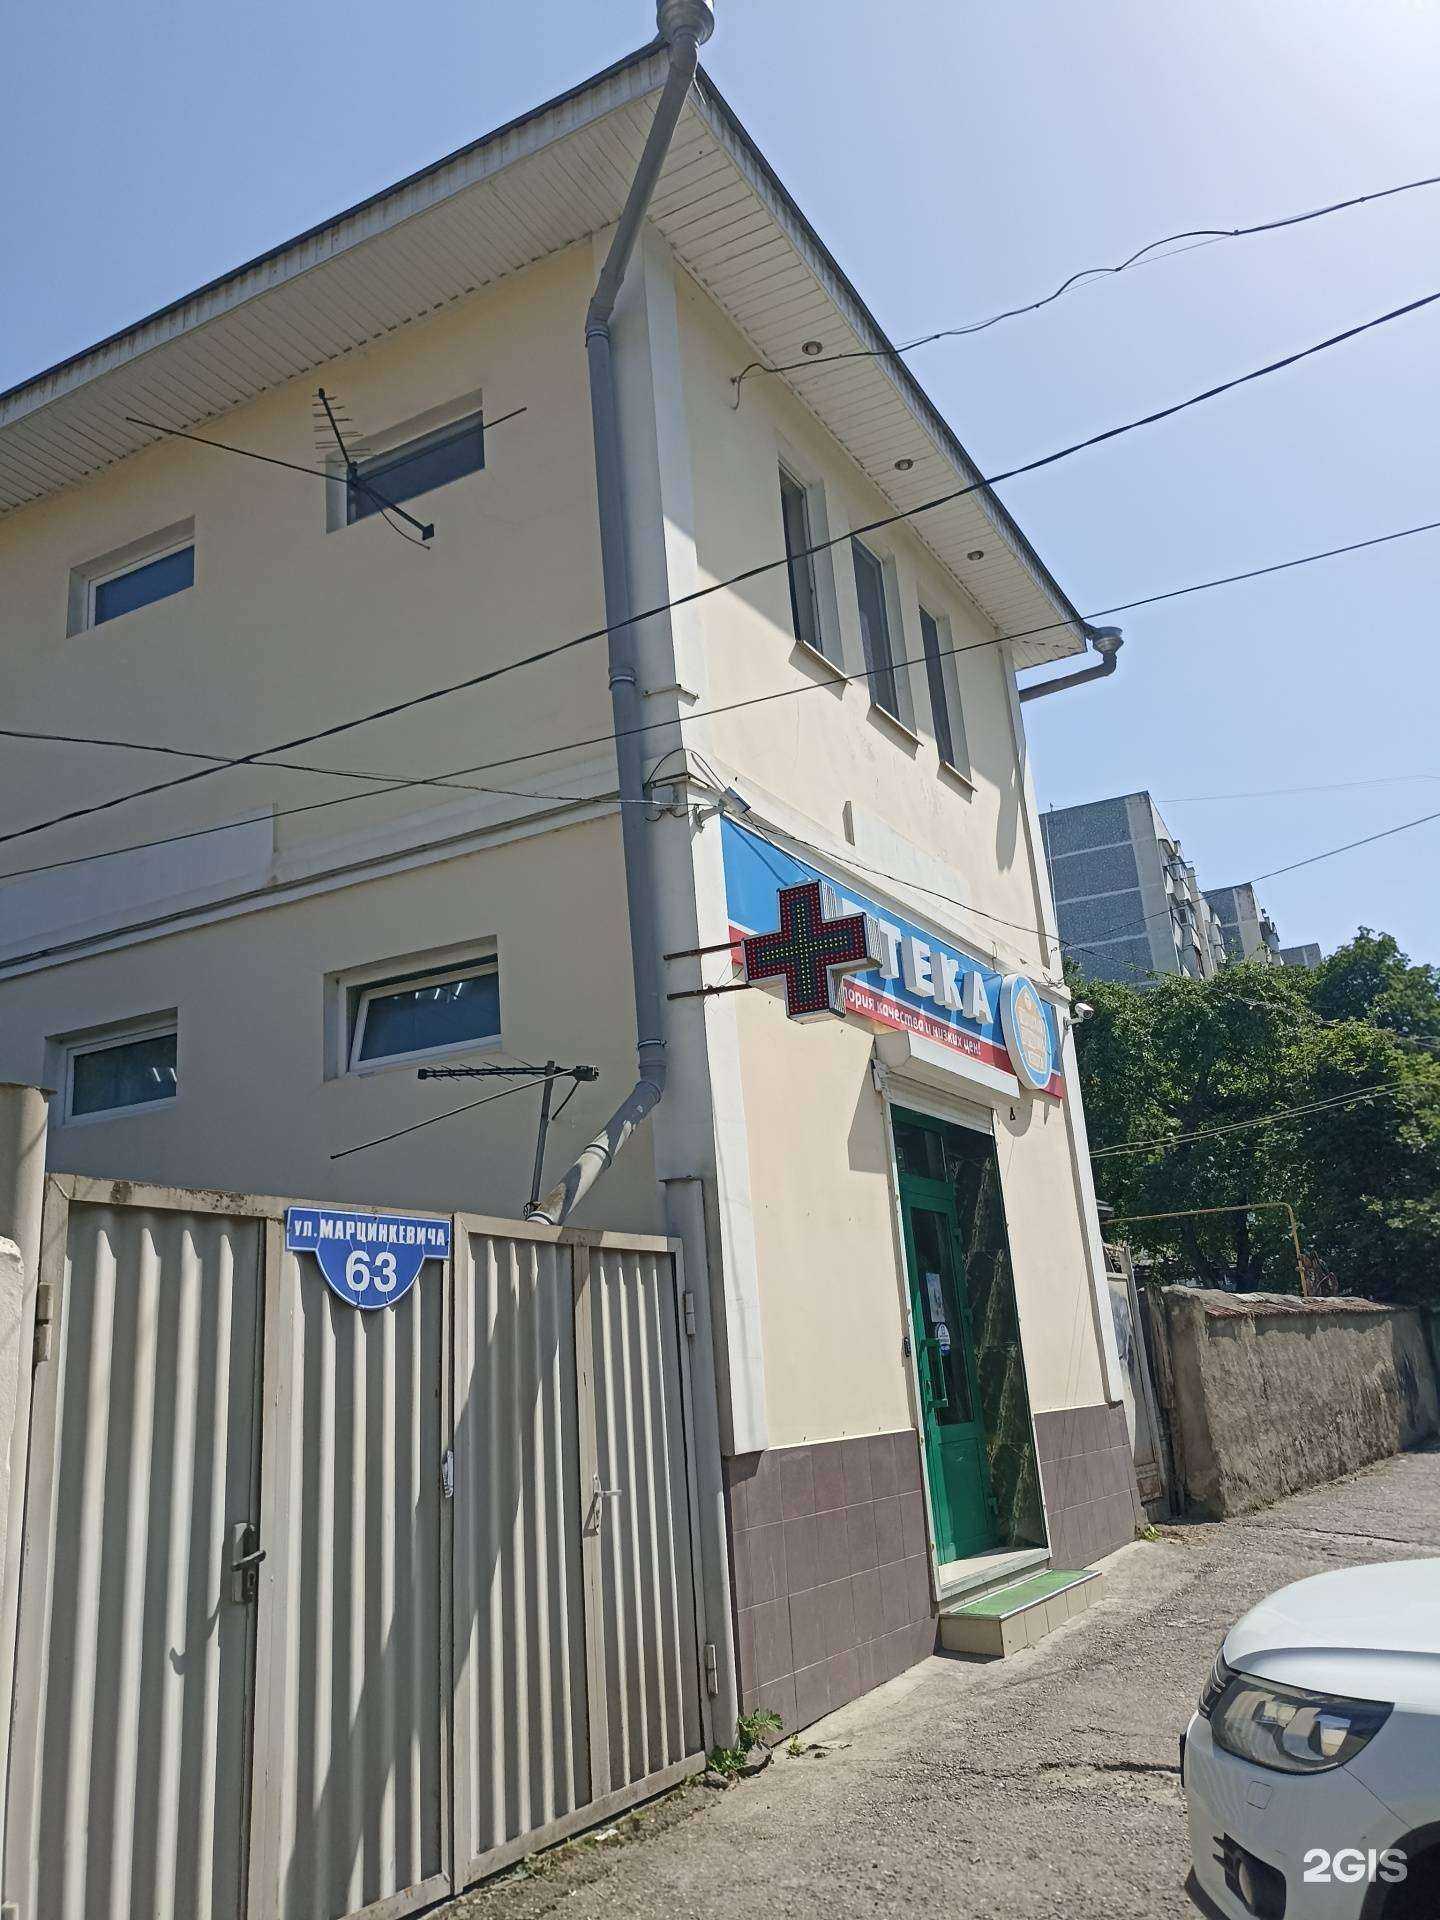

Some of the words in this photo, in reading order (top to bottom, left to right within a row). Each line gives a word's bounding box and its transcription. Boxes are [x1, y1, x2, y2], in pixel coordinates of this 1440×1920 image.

[877, 1001, 924, 1032] качества
[932, 1025, 963, 1047] низких
[963, 1037, 981, 1055] цен!
[319, 1219, 446, 1247] МАРЦИНКЕВИЧА
[345, 1250, 397, 1293] 63
